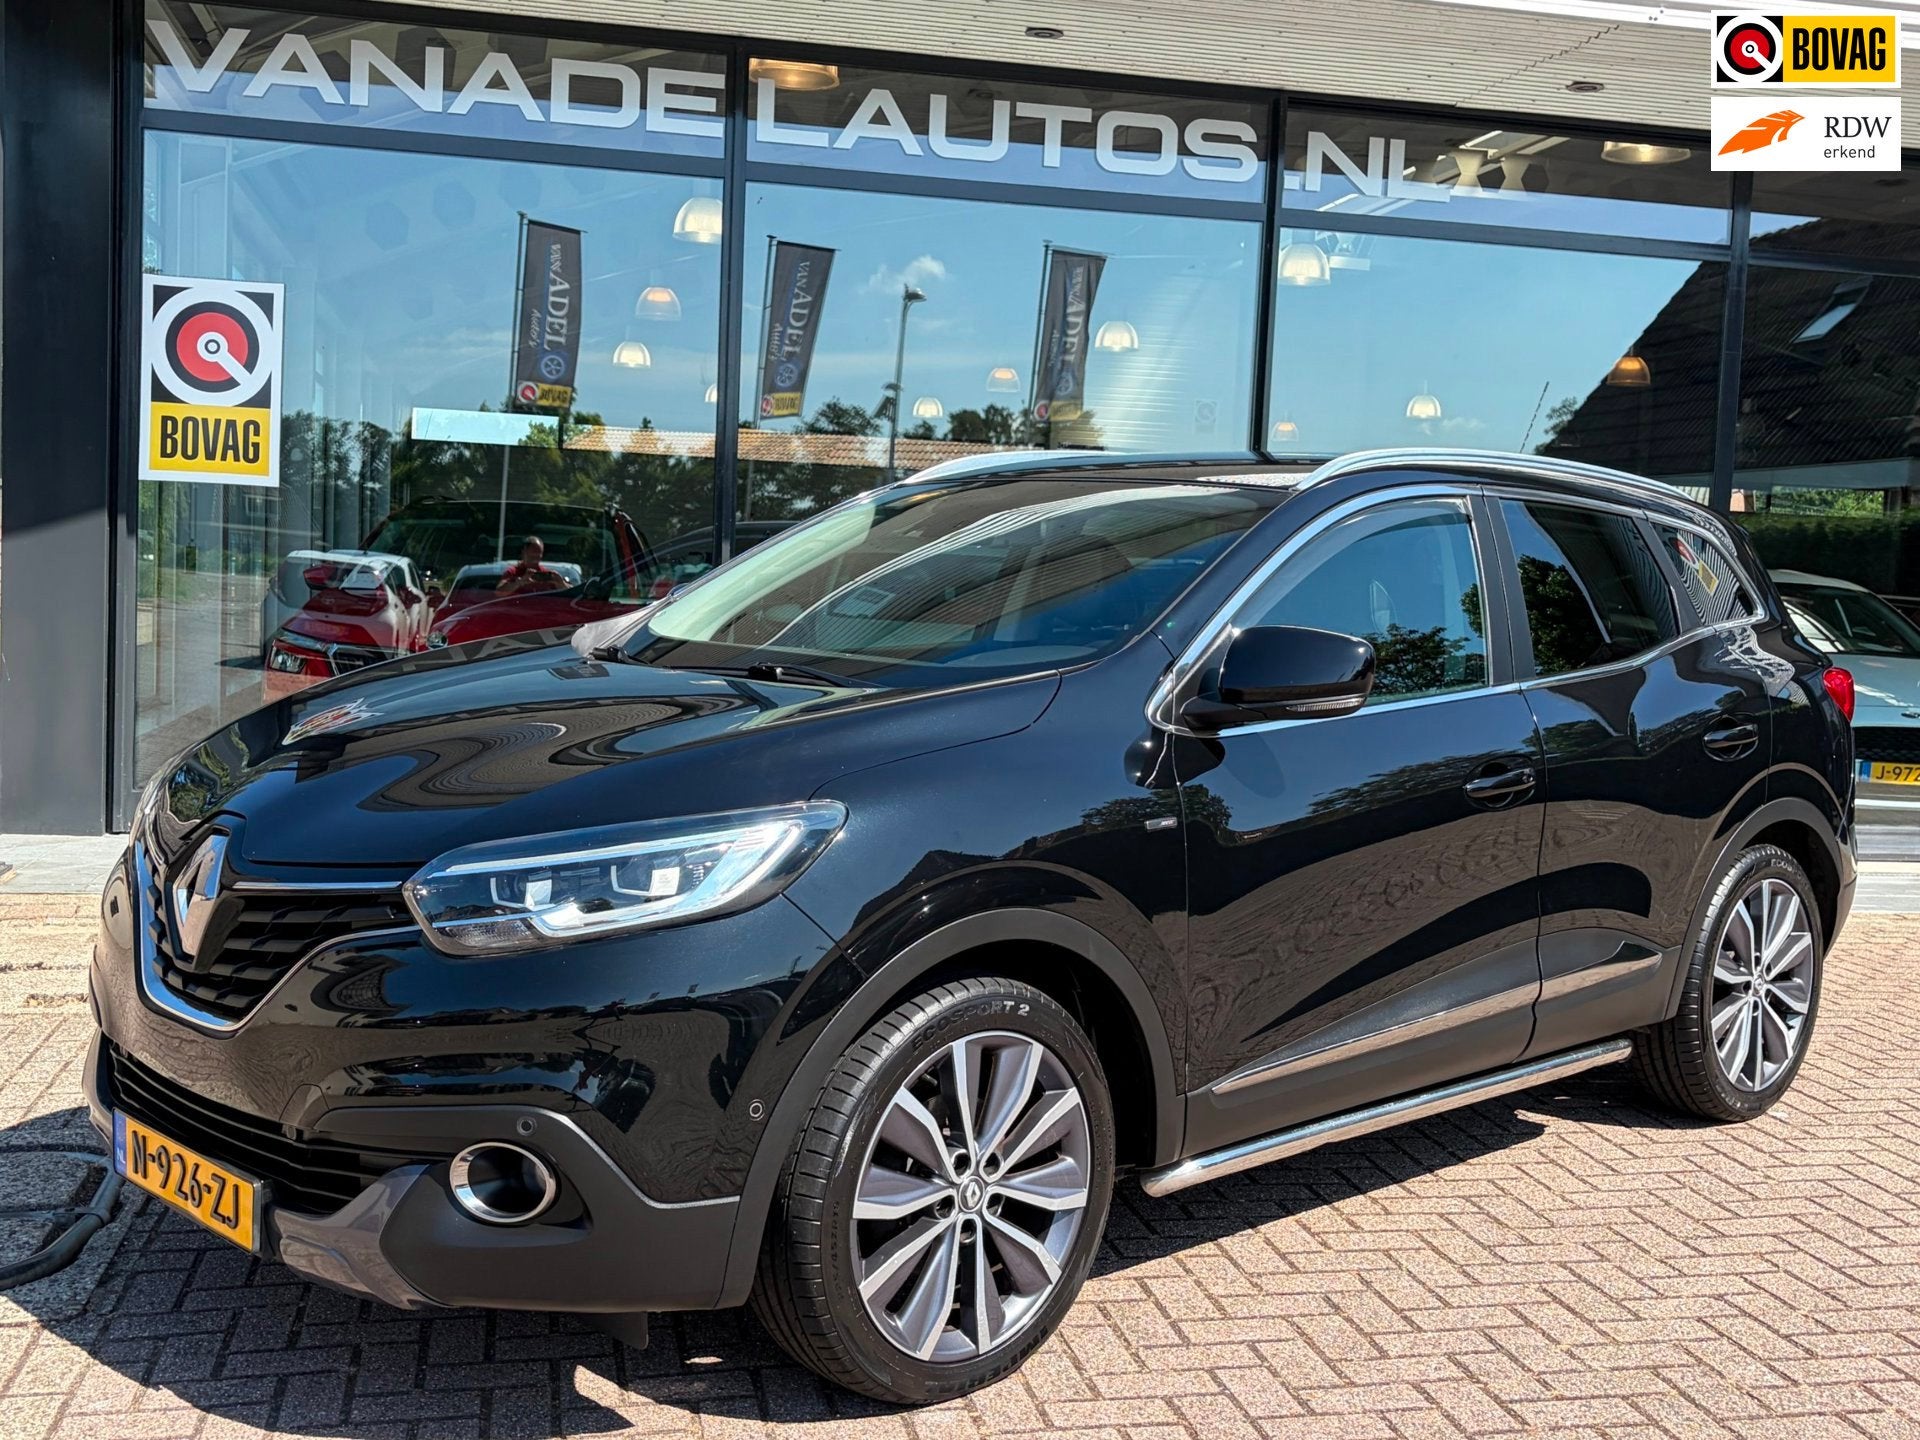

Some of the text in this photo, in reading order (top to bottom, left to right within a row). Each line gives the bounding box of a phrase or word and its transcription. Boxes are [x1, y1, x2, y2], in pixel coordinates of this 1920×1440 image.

[543, 270, 571, 351] ADEL
[159, 415, 261, 464] BOVAG
[1017, 1003, 1031, 1017] 2
[131, 1129, 240, 1230] N-926-ZJ
